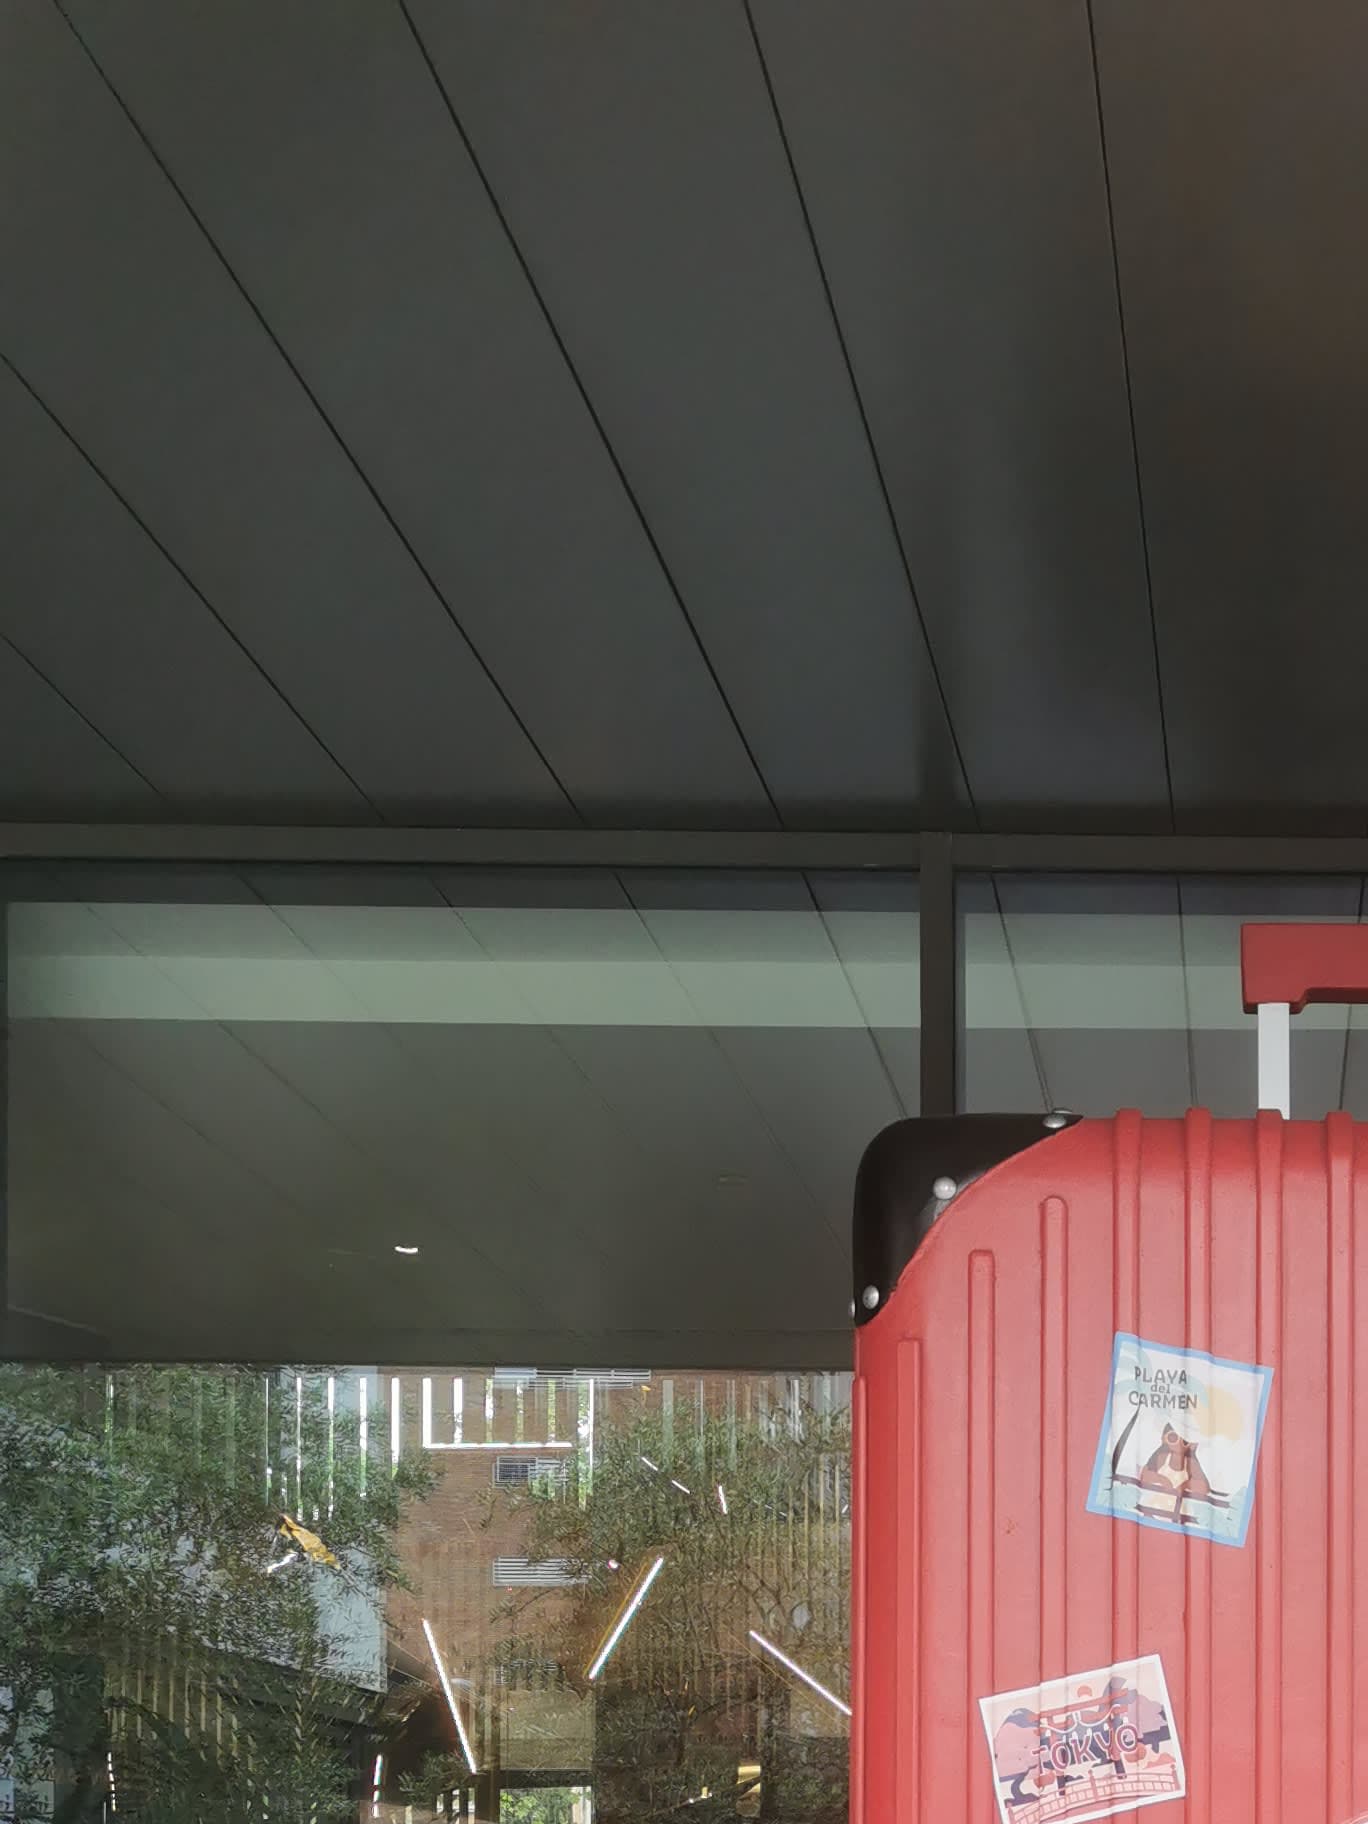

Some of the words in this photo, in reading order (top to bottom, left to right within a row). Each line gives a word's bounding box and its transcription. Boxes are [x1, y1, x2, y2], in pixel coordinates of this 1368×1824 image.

[1134, 1366, 1188, 1385] PLAYA
[1150, 1382, 1171, 1394] del
[1128, 1390, 1198, 1409] CARMEN
[1032, 1723, 1139, 1775] TOKYO
